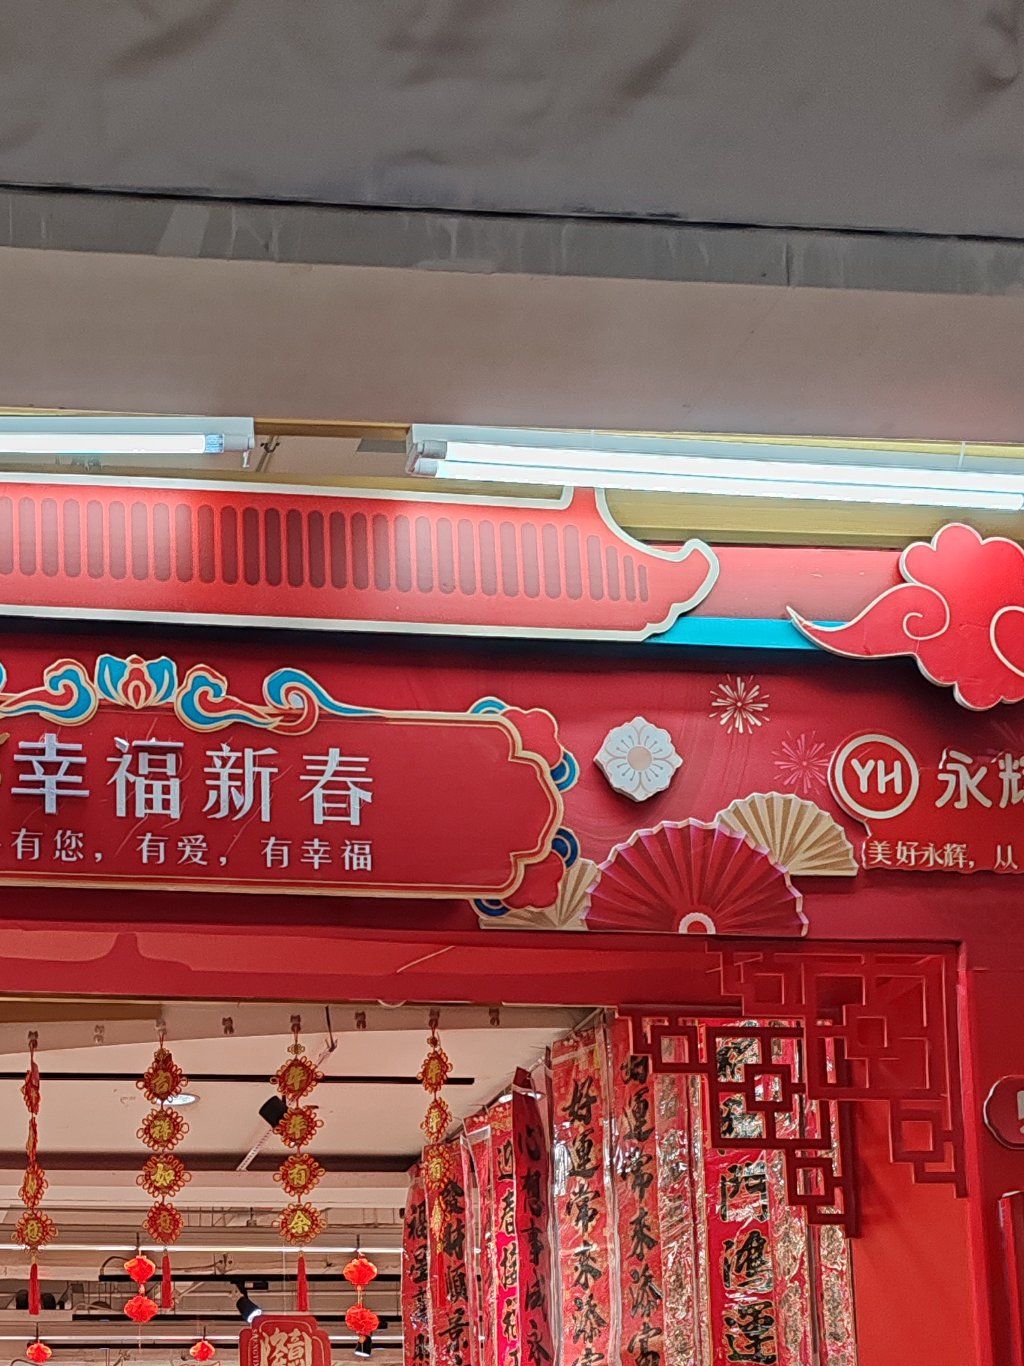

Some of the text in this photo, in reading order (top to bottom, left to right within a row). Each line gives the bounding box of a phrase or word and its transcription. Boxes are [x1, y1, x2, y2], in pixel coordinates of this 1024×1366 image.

[10, 730, 375, 826] 幸福新春
[850, 758, 904, 796] YH
